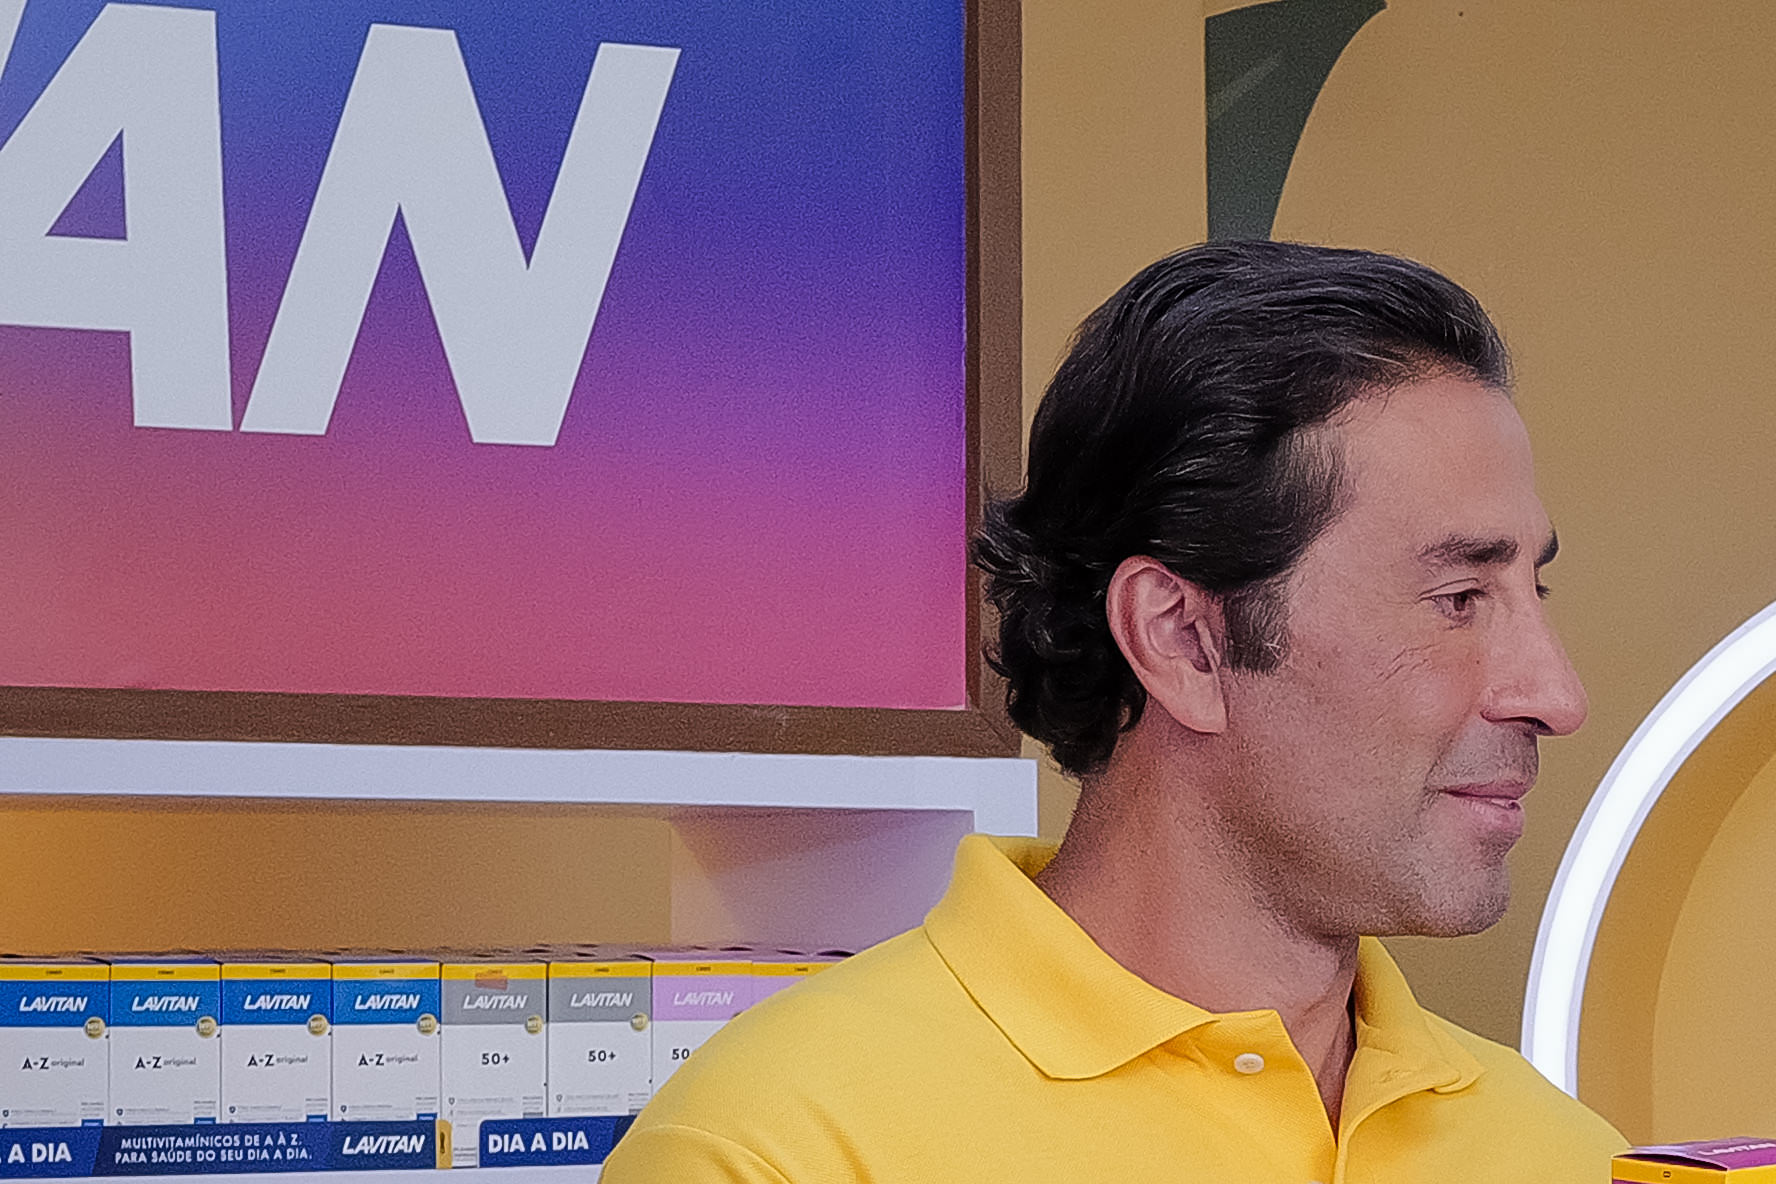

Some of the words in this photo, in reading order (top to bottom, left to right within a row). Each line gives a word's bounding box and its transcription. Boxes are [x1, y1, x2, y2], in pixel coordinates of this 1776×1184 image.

[0, 2, 682, 446] AN
[19, 996, 88, 1012] LAVITAN
[355, 994, 420, 1010] LAVITAN
[463, 995, 527, 1010] LAVITAN
[570, 992, 632, 1008] LAVITAN
[21, 1057, 49, 1069] A-Z
[358, 1053, 384, 1066] A-Z
[481, 1051, 510, 1066] 50+
[588, 1049, 616, 1063] 50+
[121, 1133, 240, 1150] MULTIVITAMÍNICOS
[245, 1135, 260, 1147] DE
[264, 1135, 274, 1147] A
[277, 1131, 287, 1146] À
[342, 1135, 425, 1155] LAVITAN
[488, 1133, 525, 1153] DIA
[531, 1132, 547, 1152] A
[552, 1130, 589, 1151] DIA
[8, 1144, 25, 1163] A
[32, 1142, 72, 1162] DIA
[115, 1151, 147, 1164] PARA
[151, 1148, 192, 1163] SAÚDE
[196, 1150, 216, 1162] DO
[220, 1149, 243, 1162] SEU
[247, 1148, 269, 1160] DIA
[273, 1148, 283, 1160] A
